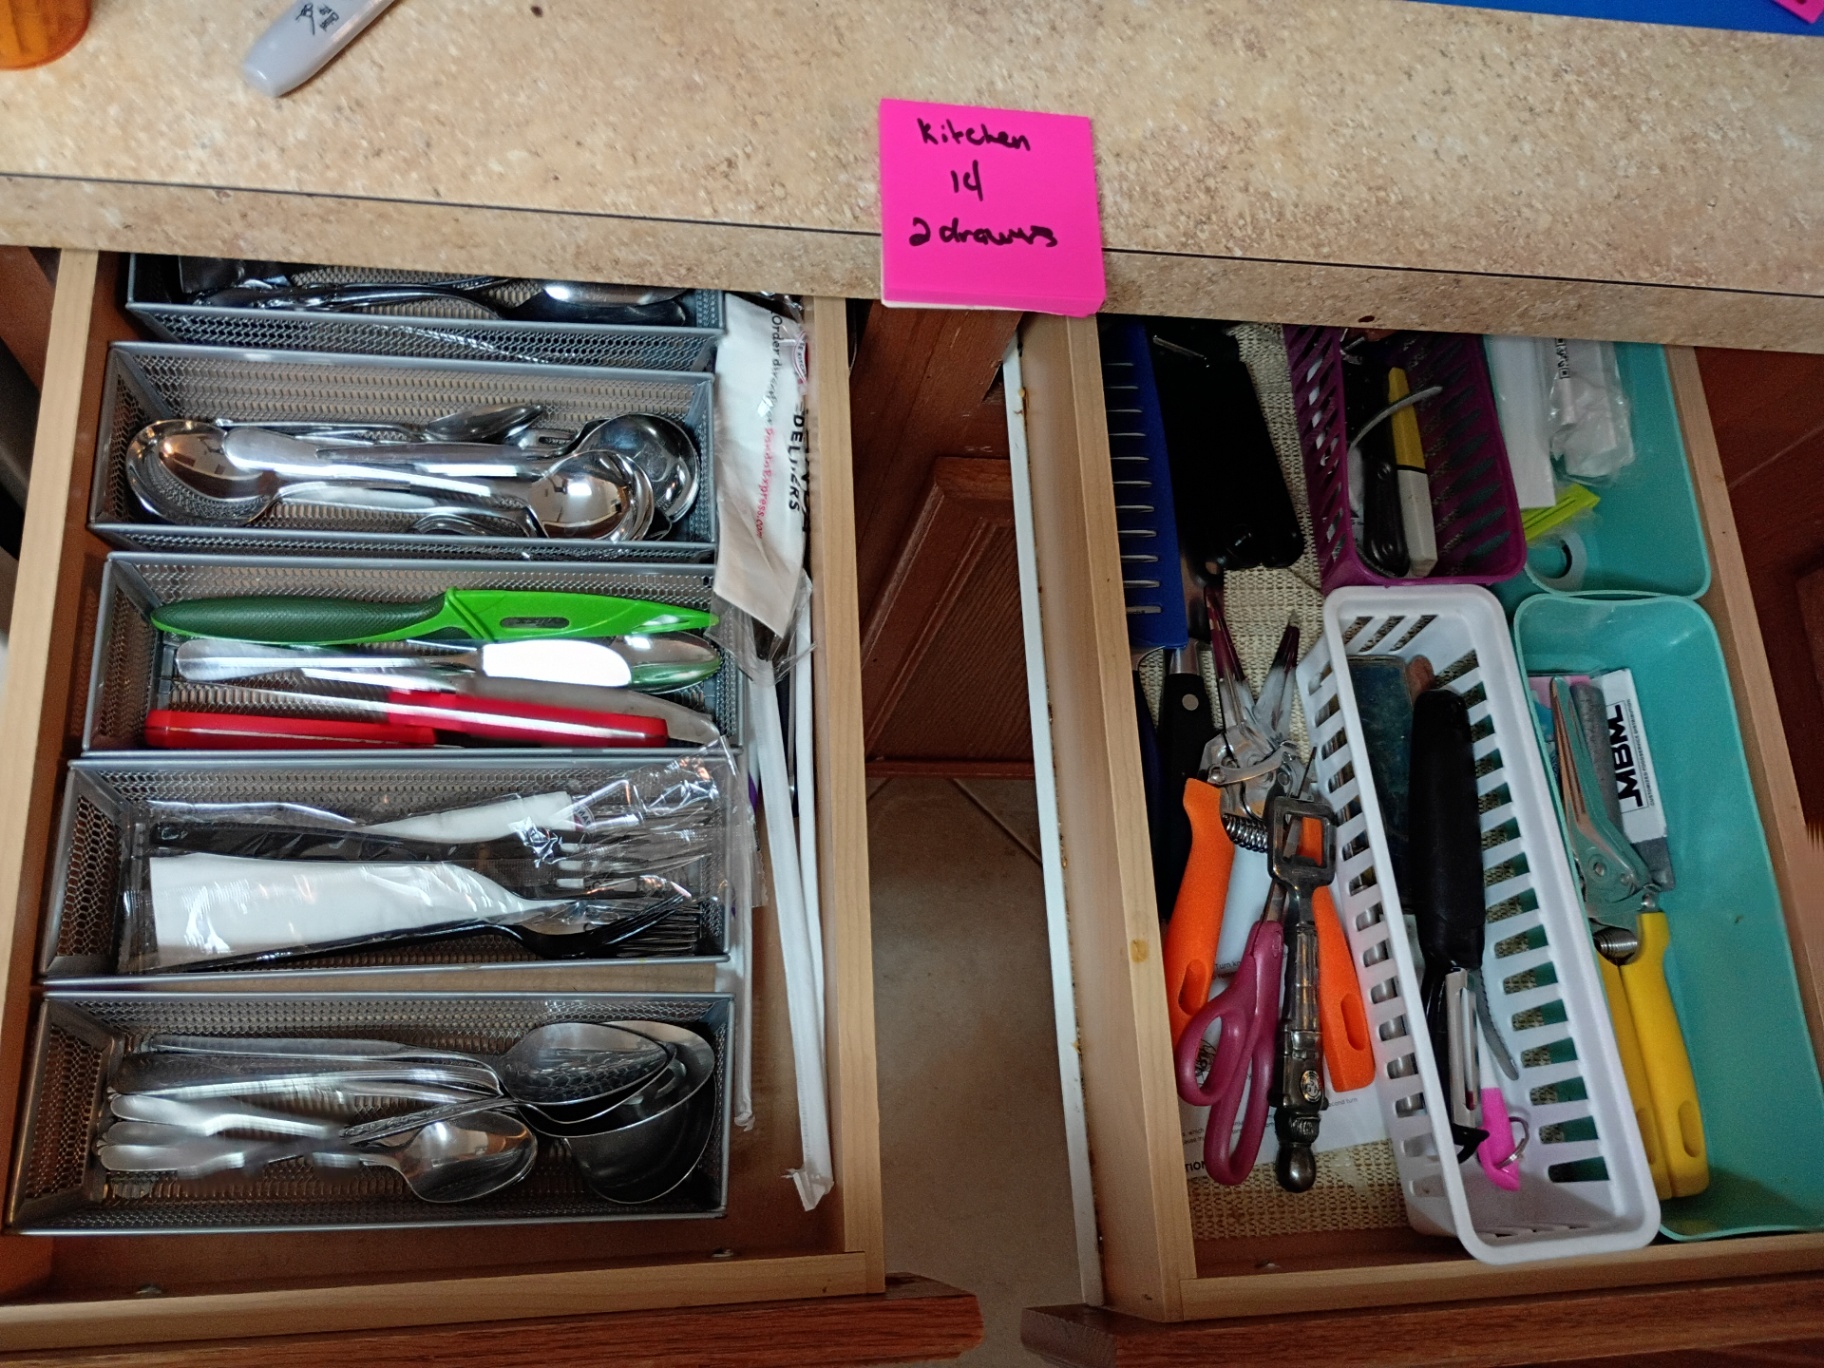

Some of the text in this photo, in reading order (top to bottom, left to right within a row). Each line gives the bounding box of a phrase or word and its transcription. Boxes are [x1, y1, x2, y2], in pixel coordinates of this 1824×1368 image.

[951, 159, 983, 202] 14
[909, 217, 931, 247] 2
[1608, 705, 1643, 807] MBM
